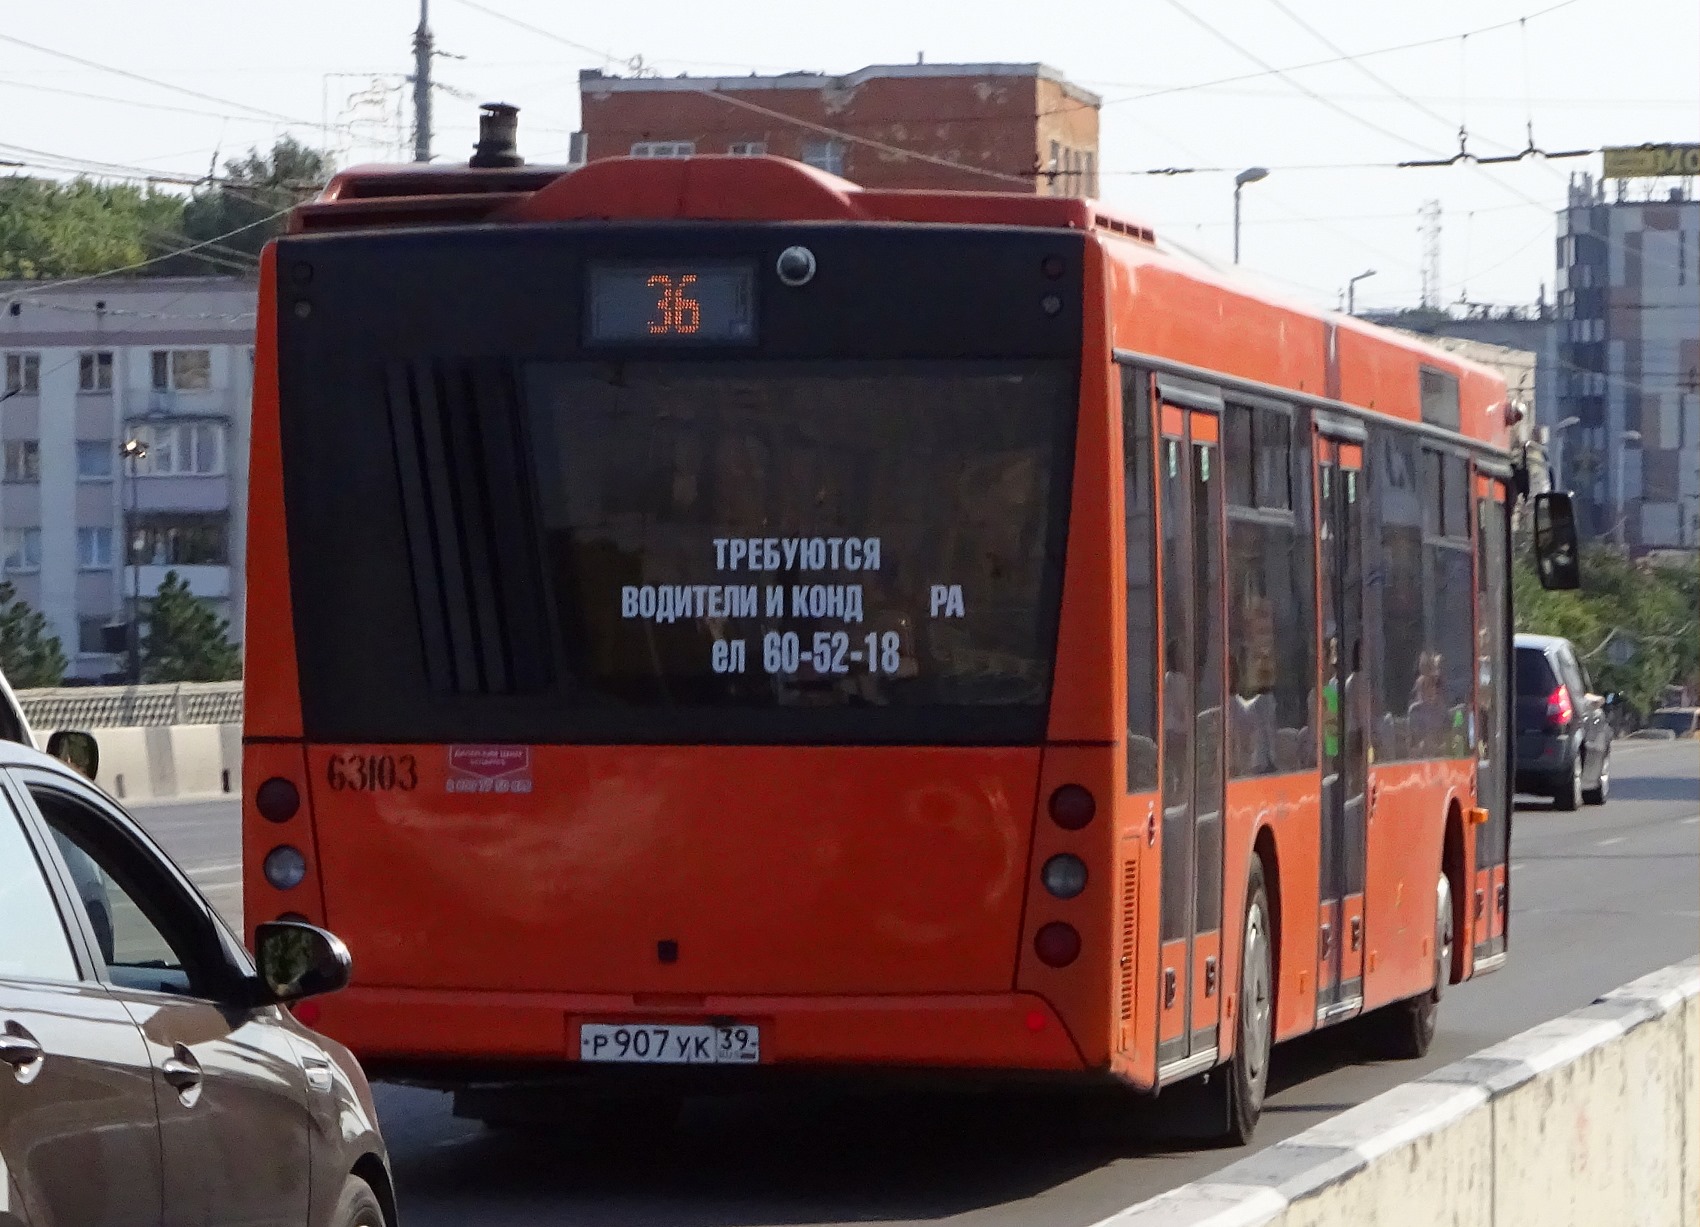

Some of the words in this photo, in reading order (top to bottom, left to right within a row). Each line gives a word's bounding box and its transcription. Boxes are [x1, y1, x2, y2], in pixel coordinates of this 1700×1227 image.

[647, 275, 700, 333] 36
[713, 537, 881, 571] ТРЕБУЮТСЯ
[621, 584, 758, 623] ВОДИТЕЛИ
[765, 584, 784, 618] И
[711, 639, 746, 673] ел
[763, 631, 901, 674] 60-52-18
[327, 754, 418, 791] 63103
[719, 1028, 749, 1050] 39
